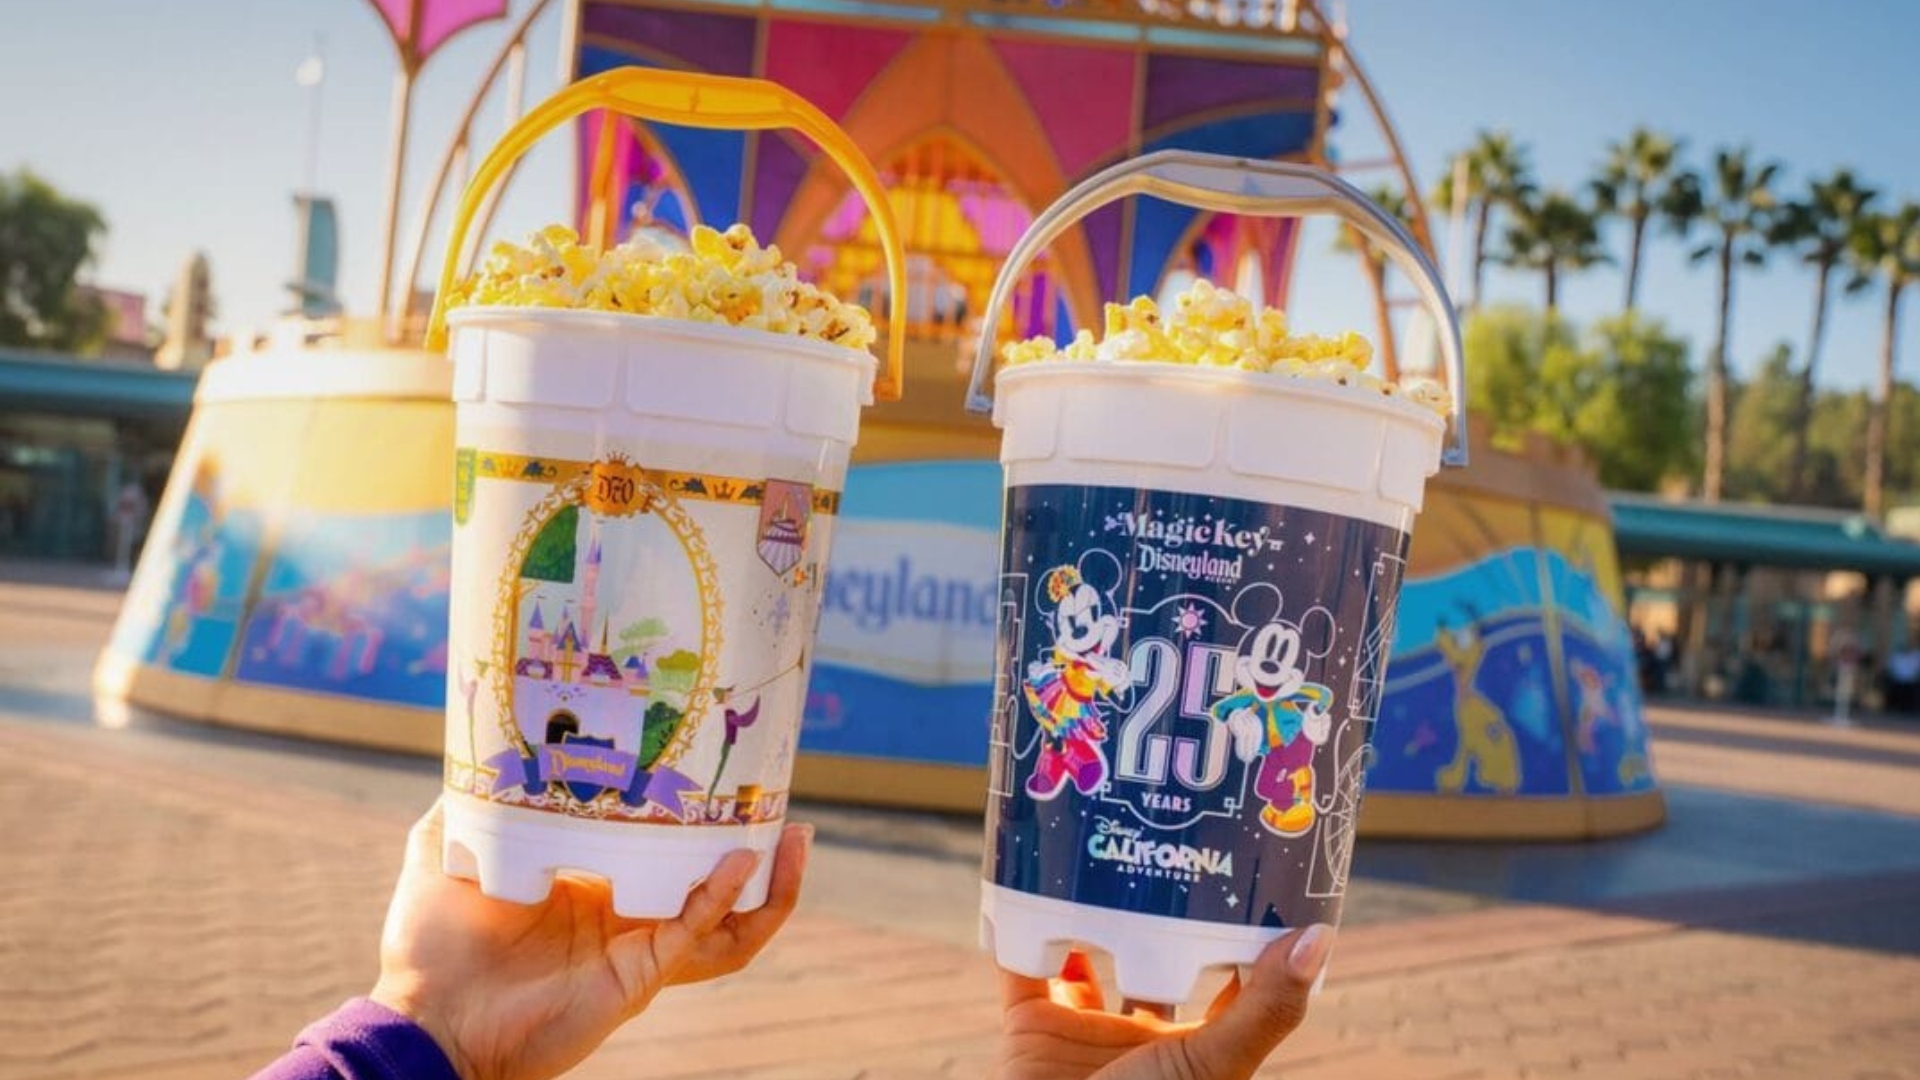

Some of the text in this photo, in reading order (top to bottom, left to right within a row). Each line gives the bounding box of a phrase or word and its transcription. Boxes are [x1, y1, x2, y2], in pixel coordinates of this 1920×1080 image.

[1119, 512, 1271, 556] Magic Key
[1137, 543, 1242, 579] Disneyland
[1114, 636, 1238, 791] 25
[1141, 792, 1191, 812] YEARS
[1087, 833, 1232, 877] CALIFORNIA
[1116, 863, 1201, 883] ADVENTURE
